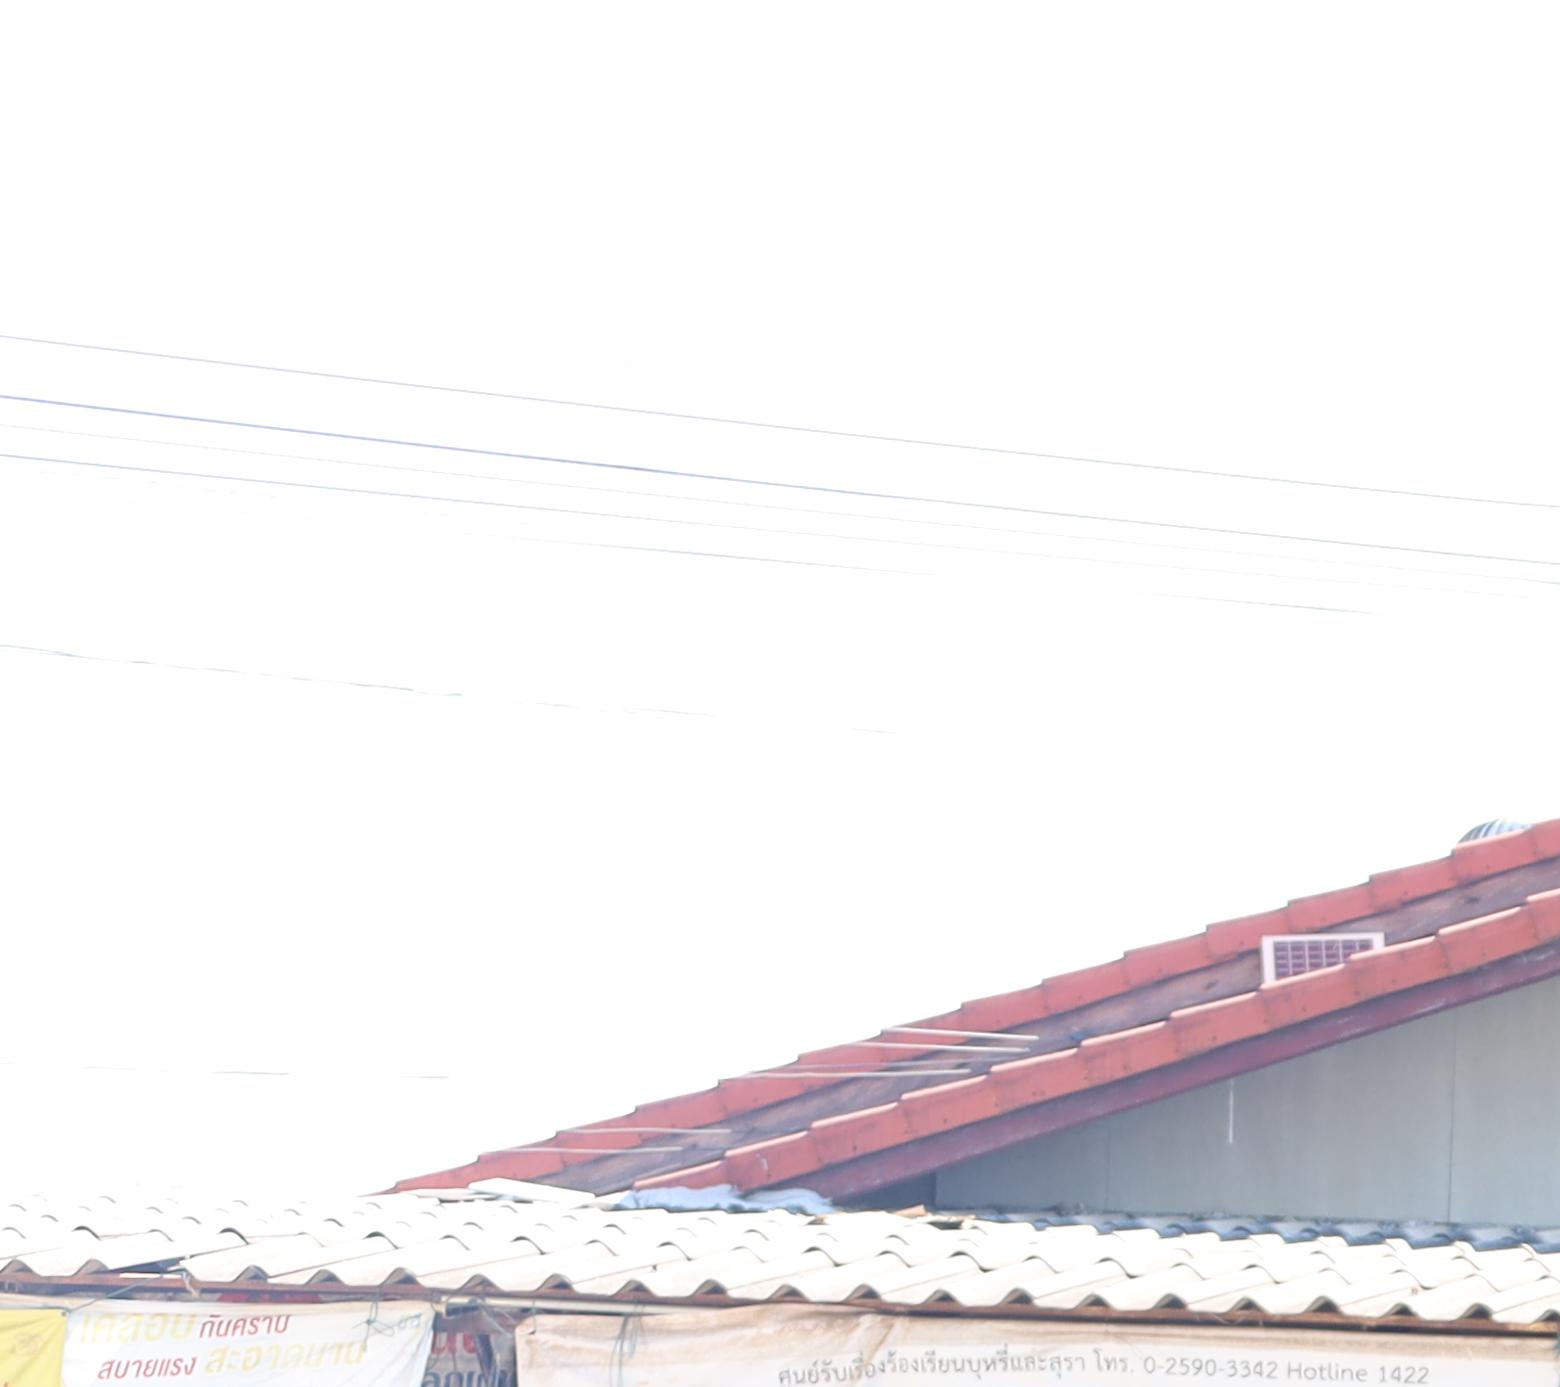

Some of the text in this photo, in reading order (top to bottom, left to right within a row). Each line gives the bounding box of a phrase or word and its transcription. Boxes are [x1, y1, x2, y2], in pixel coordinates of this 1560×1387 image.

[1093, 1348, 1134, 1374] โทร.
[1144, 1356, 1278, 1379] 0-2590-3342
[1287, 1361, 1368, 1383] Hotline
[1379, 1366, 1429, 1385] 1422
